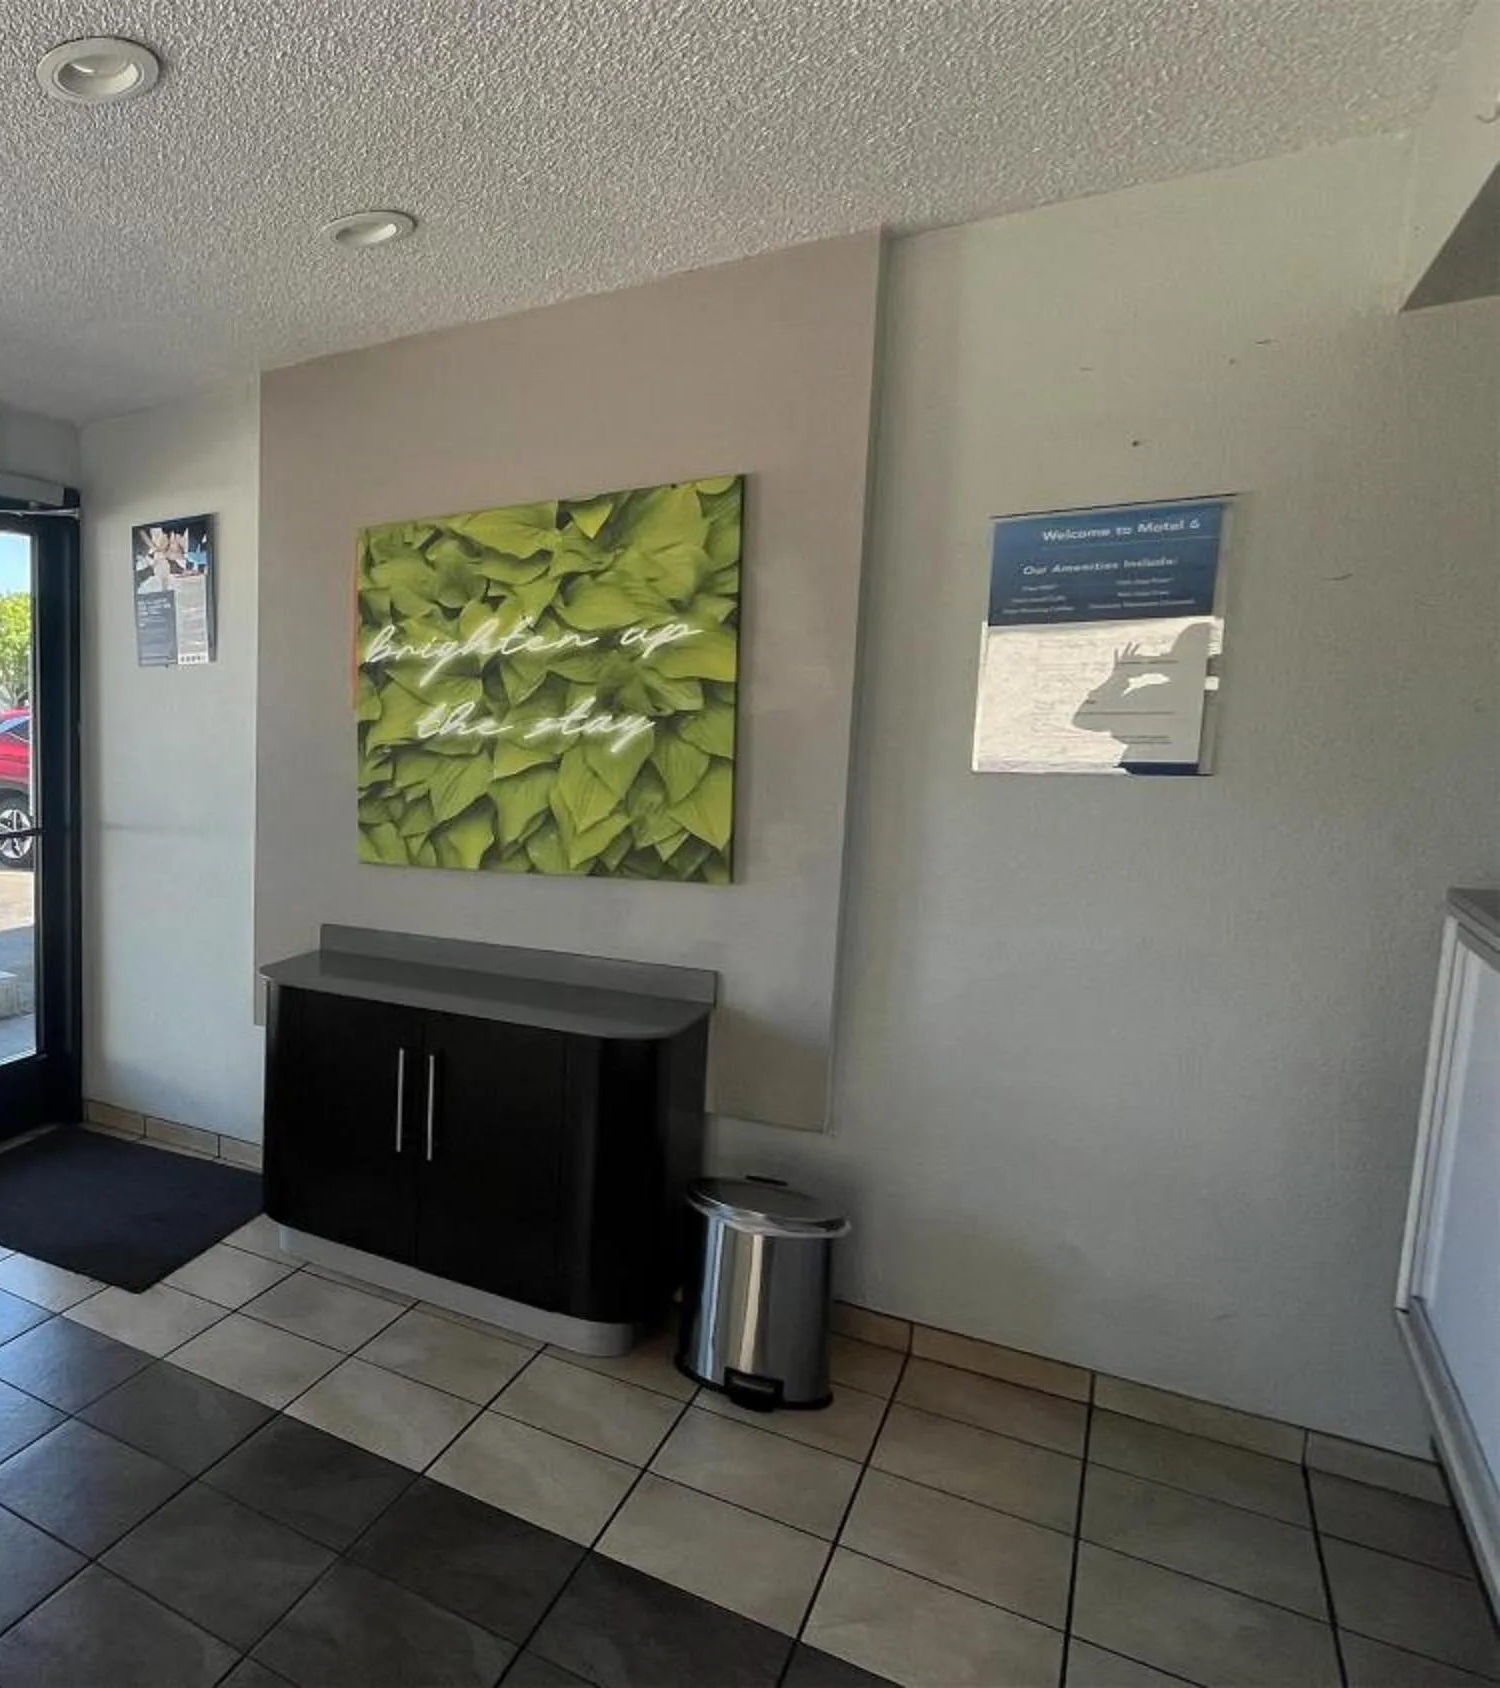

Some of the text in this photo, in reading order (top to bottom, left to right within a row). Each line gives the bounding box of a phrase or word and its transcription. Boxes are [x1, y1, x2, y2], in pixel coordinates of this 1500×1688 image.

[1042, 517, 1200, 541] Welcome to Motel 6
[1022, 564, 1047, 576] Our
[1051, 561, 1119, 574] Amenities
[364, 614, 704, 688] brighten up
[416, 696, 656, 753] the stay
